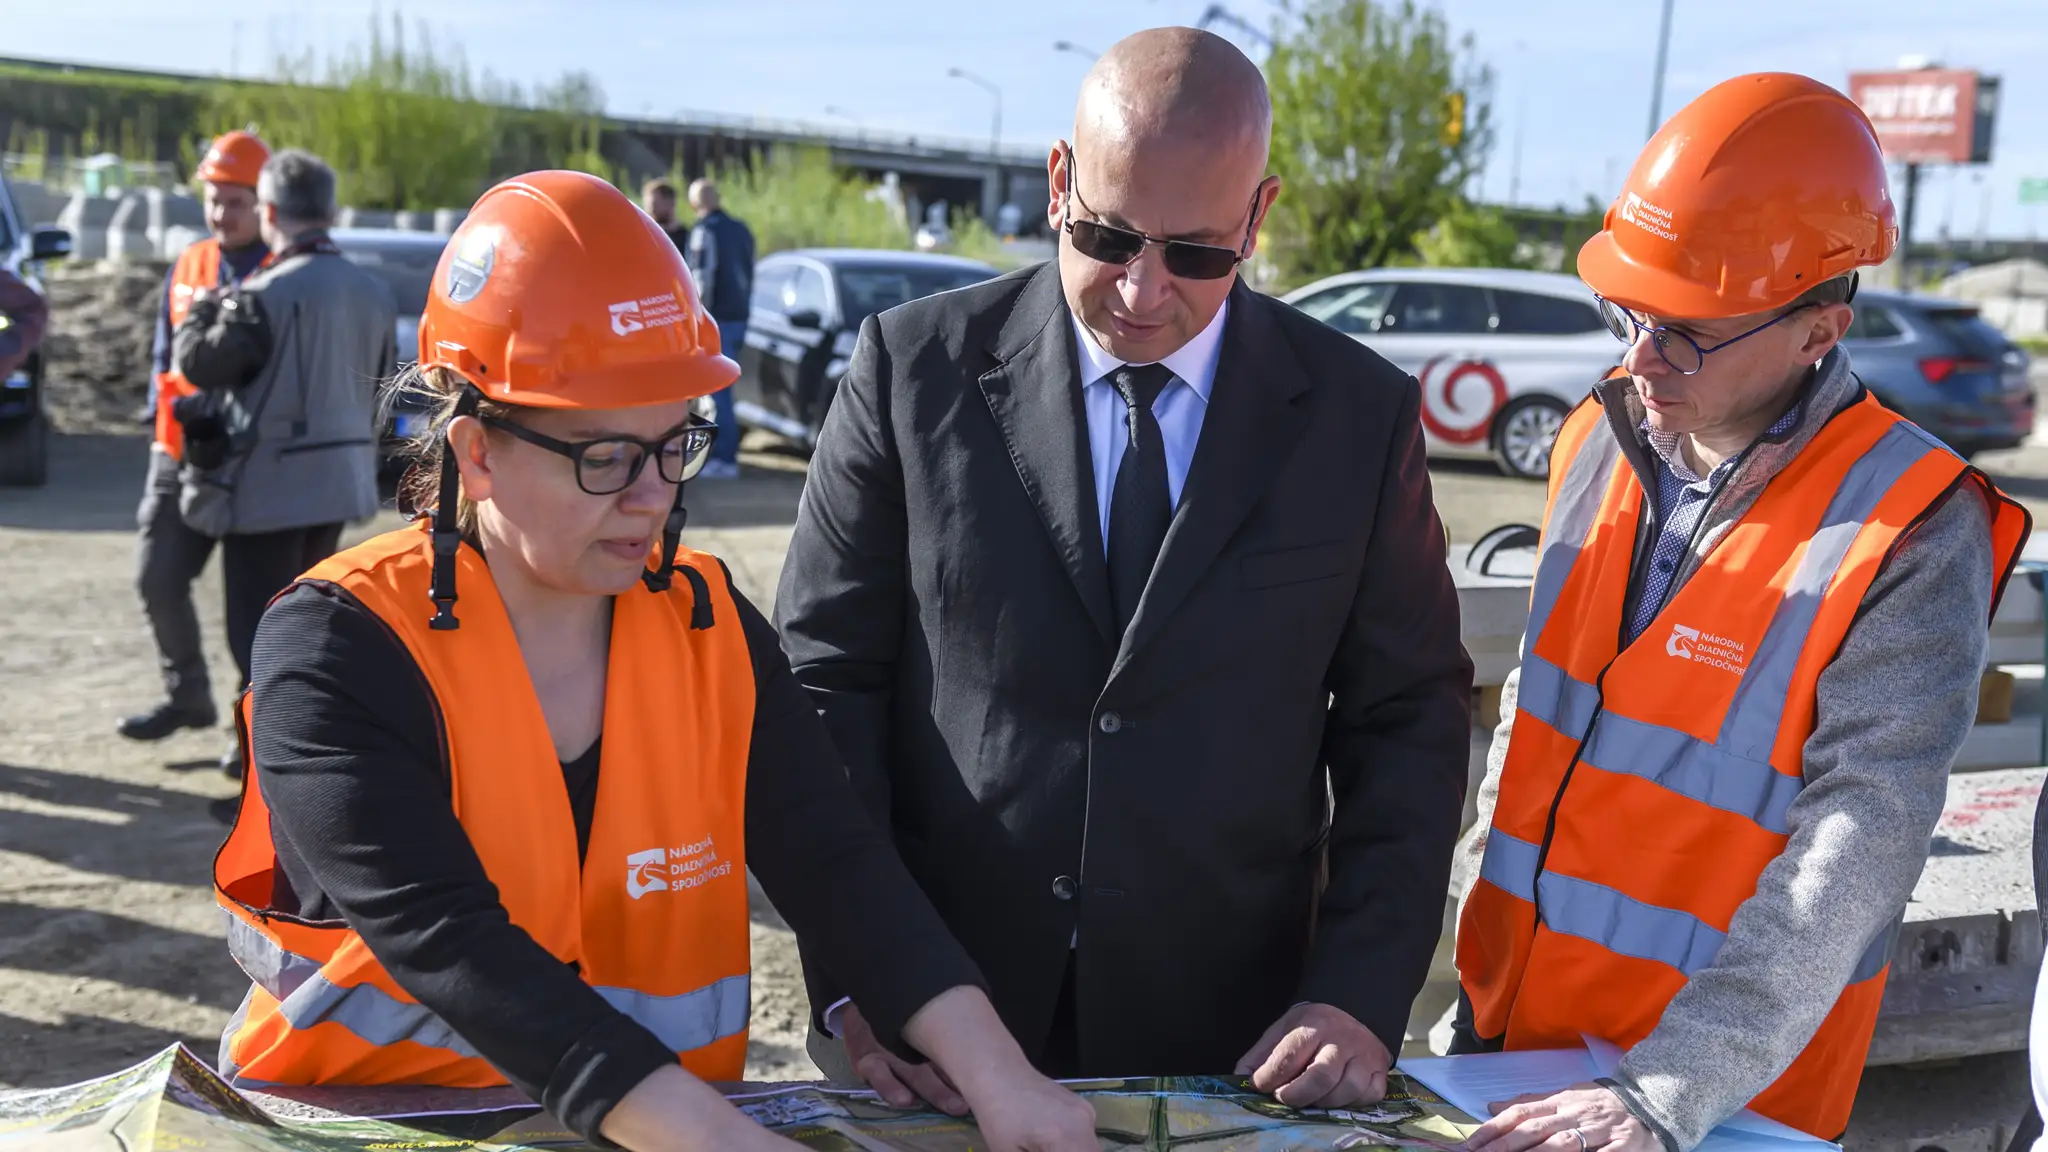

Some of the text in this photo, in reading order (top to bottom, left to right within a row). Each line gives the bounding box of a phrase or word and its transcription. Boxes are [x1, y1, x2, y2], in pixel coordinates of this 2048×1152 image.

[1641, 200, 1673, 220] NÁRODNÁ
[1635, 218, 1679, 242] SPOLOČNOSŤ
[1700, 632, 1745, 653] NÁRODNÁ
[1697, 643, 1743, 664] DIAĽNIČNÁ
